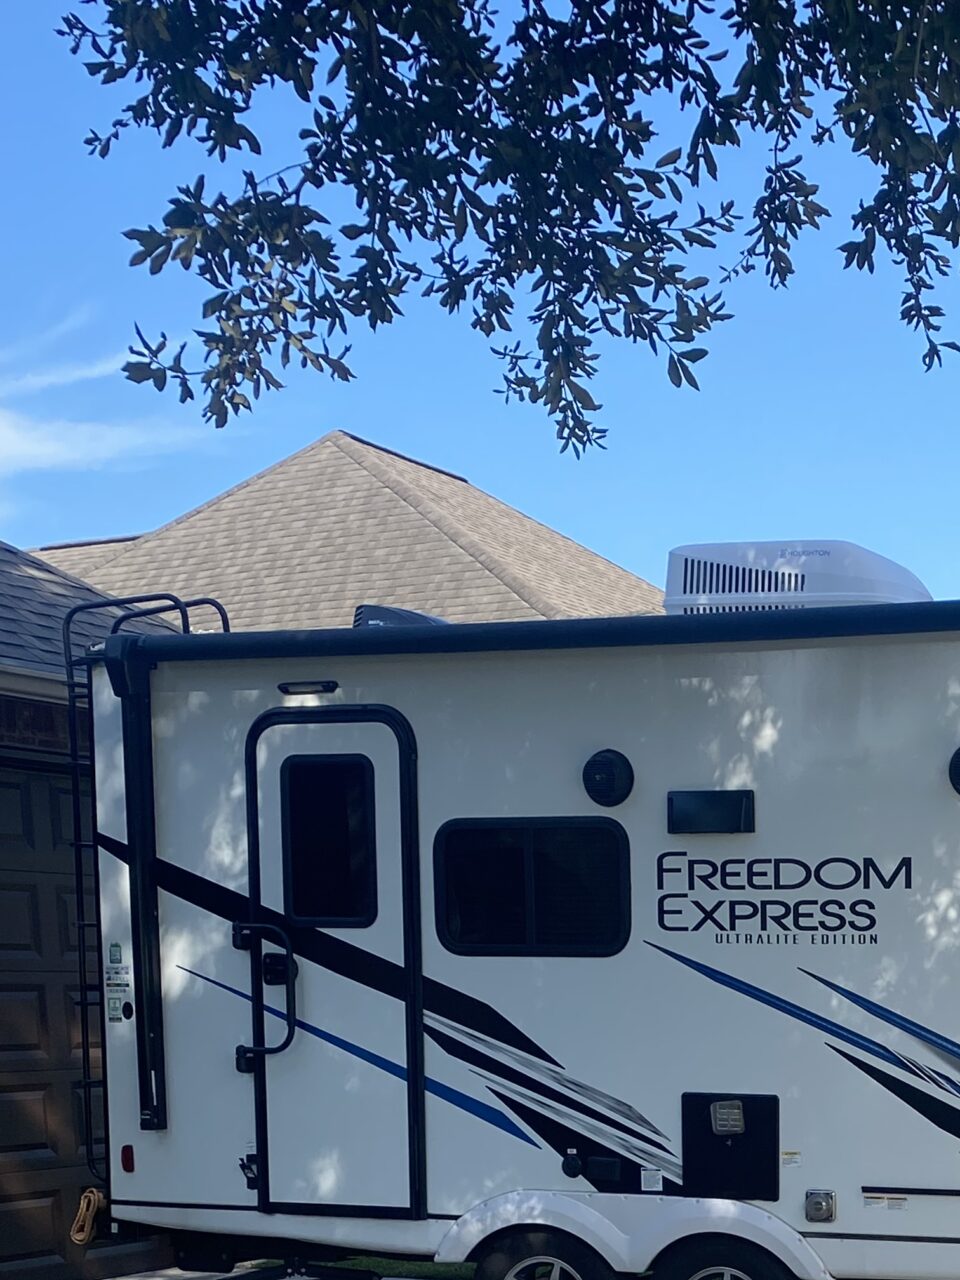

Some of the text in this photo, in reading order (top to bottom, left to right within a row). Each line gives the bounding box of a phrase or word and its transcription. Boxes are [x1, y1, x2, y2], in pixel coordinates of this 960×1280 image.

[656, 851, 912, 891] FREEDOM
[657, 893, 877, 932] EXPRESS
[715, 933, 879, 945] ULTRALITE EDITION
